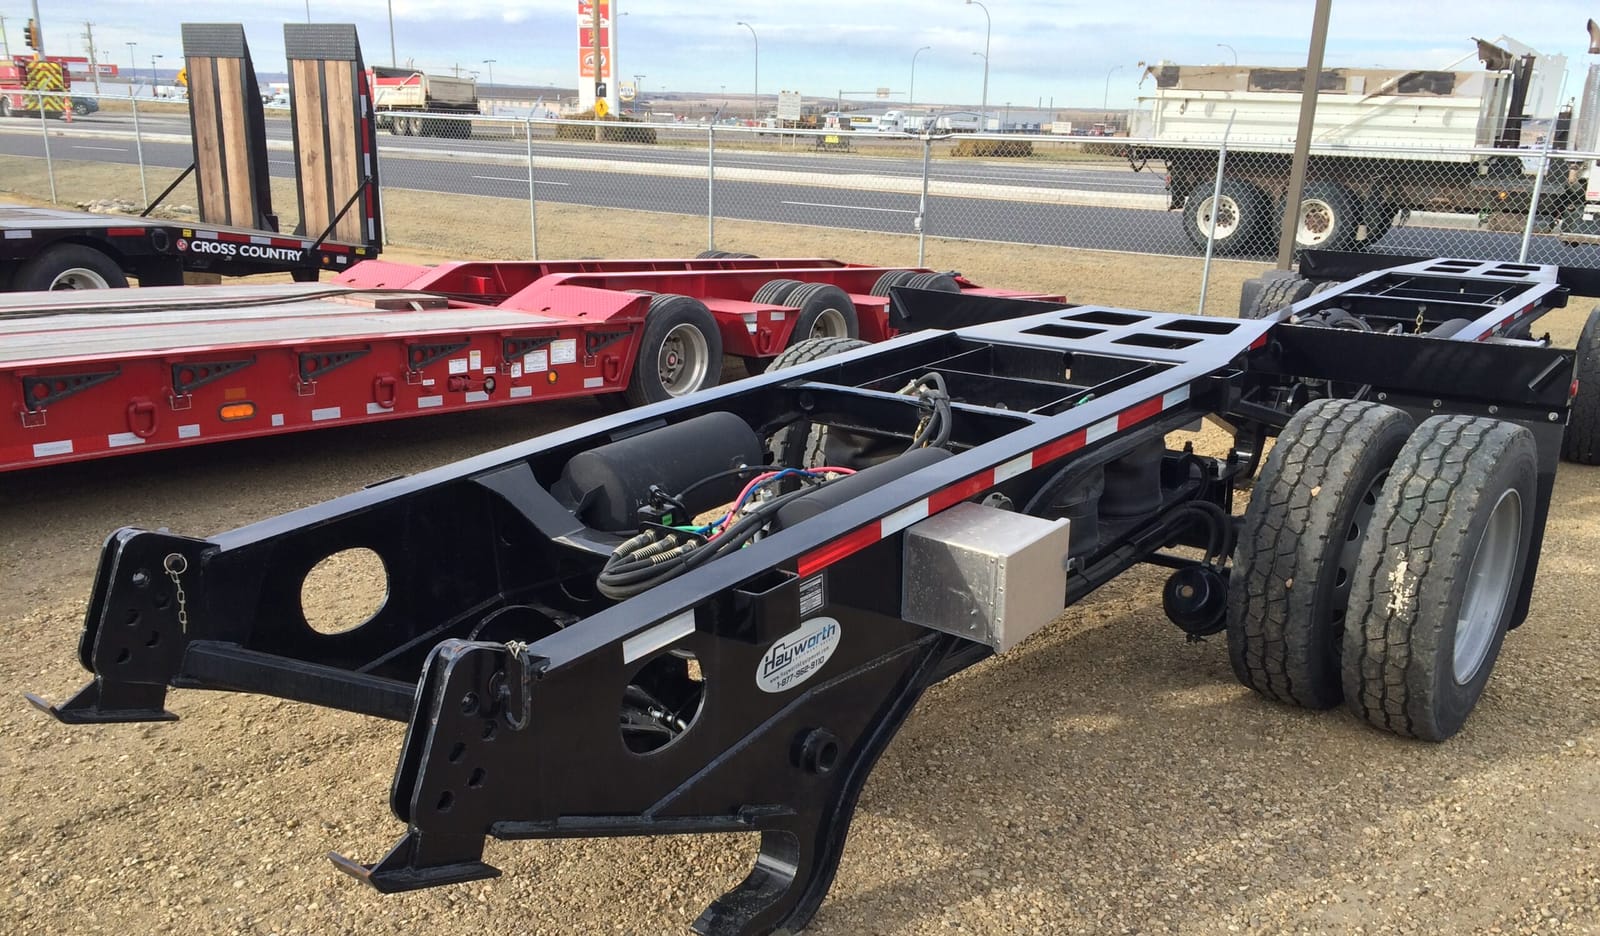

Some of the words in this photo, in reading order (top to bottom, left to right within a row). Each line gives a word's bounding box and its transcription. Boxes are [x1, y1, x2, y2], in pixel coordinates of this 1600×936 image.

[191, 240, 236, 256] CROSS
[239, 245, 303, 262] COUNTRY
[763, 623, 836, 677] Hayworth
